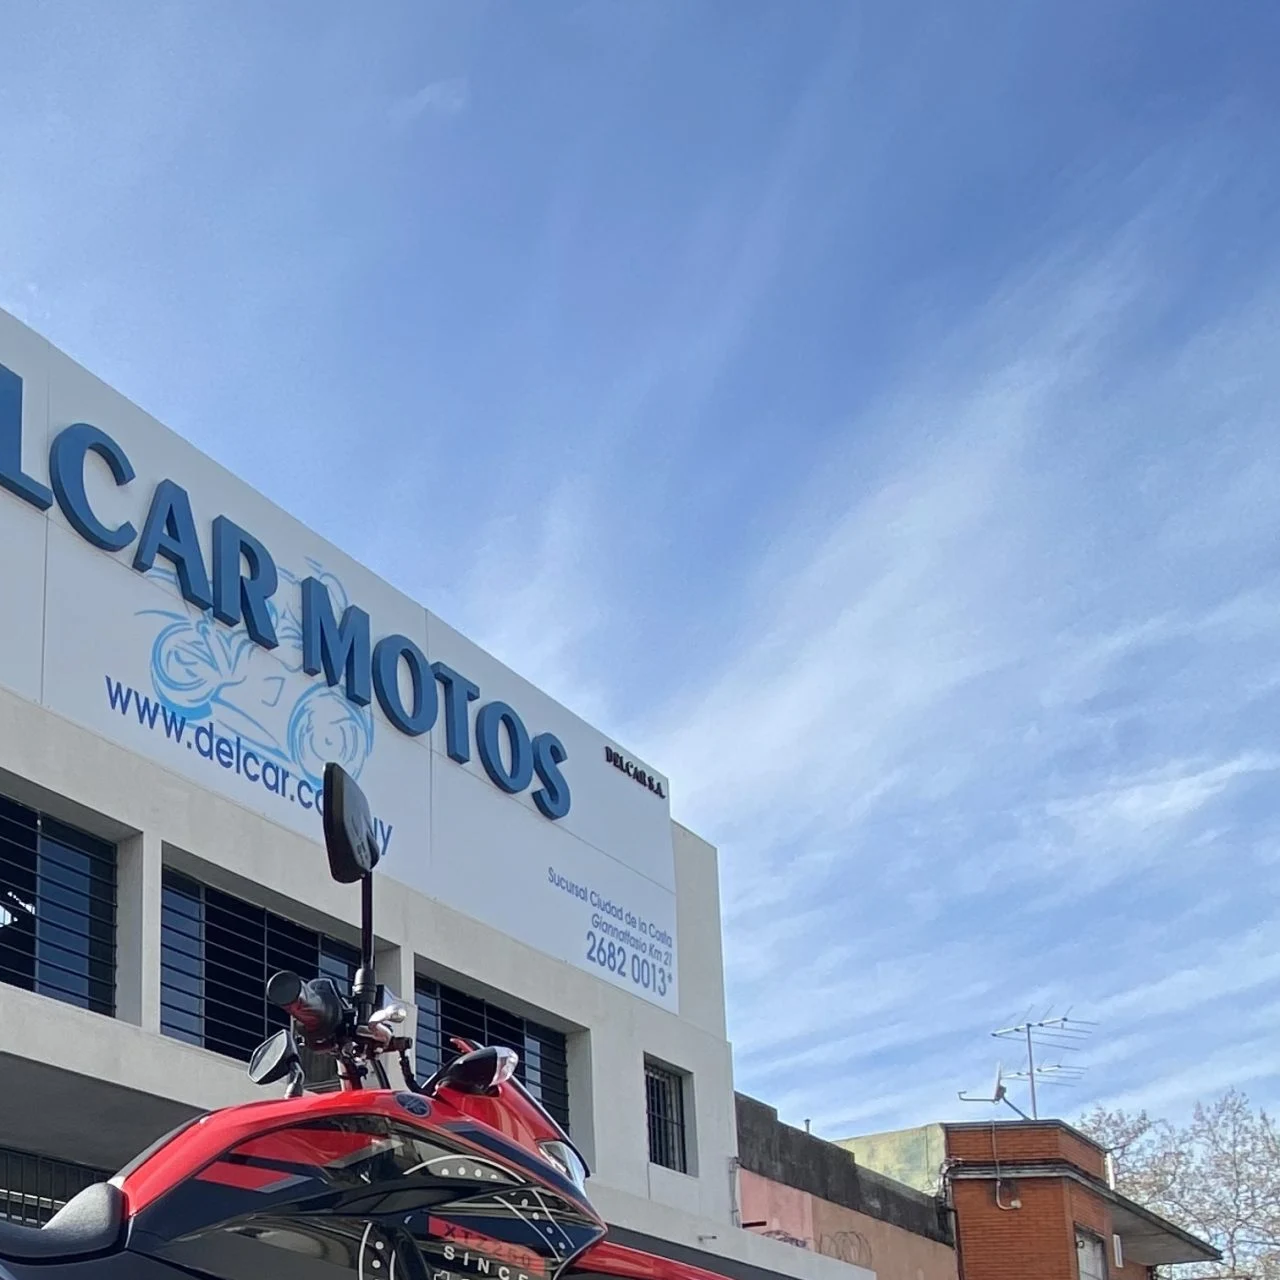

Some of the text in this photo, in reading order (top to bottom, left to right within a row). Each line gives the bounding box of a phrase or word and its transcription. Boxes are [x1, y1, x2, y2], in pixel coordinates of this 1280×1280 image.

[303, 576, 572, 820] MOTOS
[605, 746, 647, 787] DELCAR
[548, 866, 673, 949] Sucursal Ciudad de la Costa
[586, 931, 627, 978] 2682
[649, 943, 663, 963] Km
